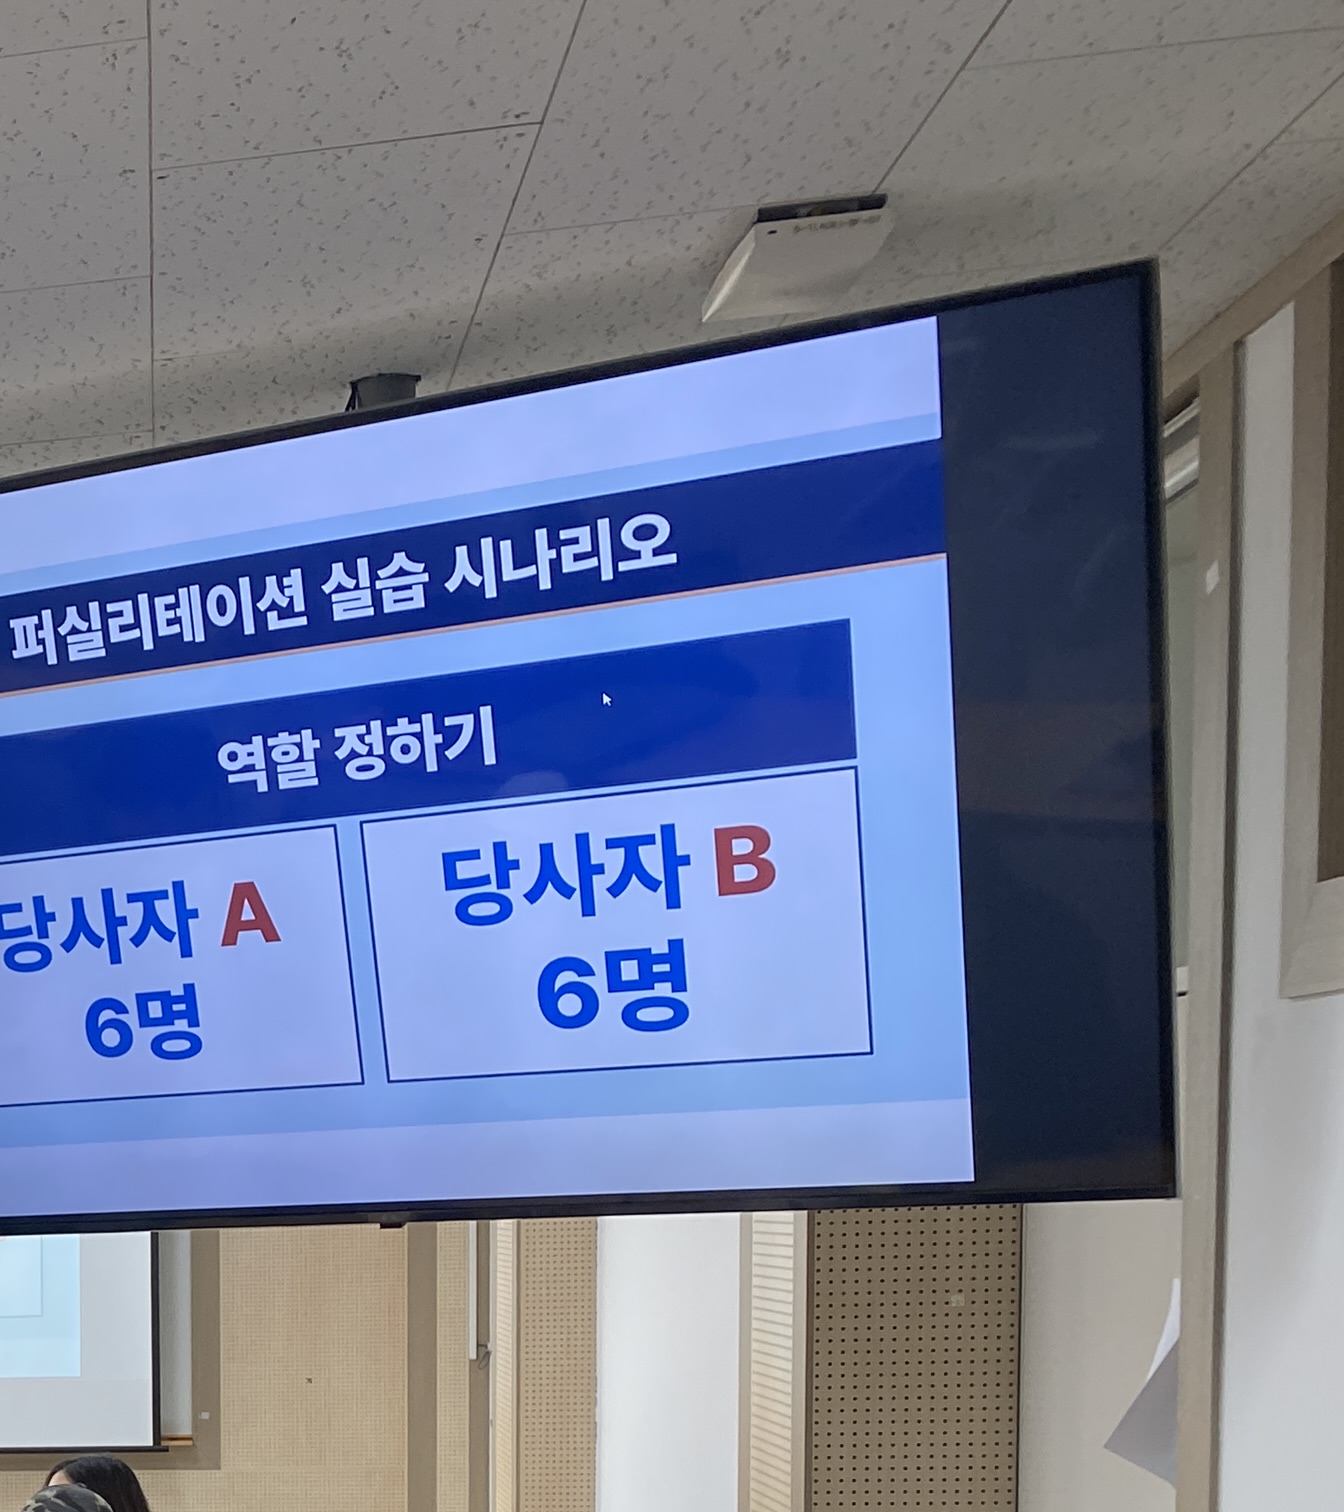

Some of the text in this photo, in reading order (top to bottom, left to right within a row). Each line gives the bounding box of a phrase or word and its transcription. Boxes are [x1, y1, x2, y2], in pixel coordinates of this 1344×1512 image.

[9, 512, 677, 665] 퍼실리테이션 실습 시나리오
[217, 705, 497, 792] 역할 정하기
[220, 881, 282, 947] A
[441, 822, 777, 927] 당사자 B
[84, 983, 204, 1061] 6명
[536, 938, 691, 1033] 6명
